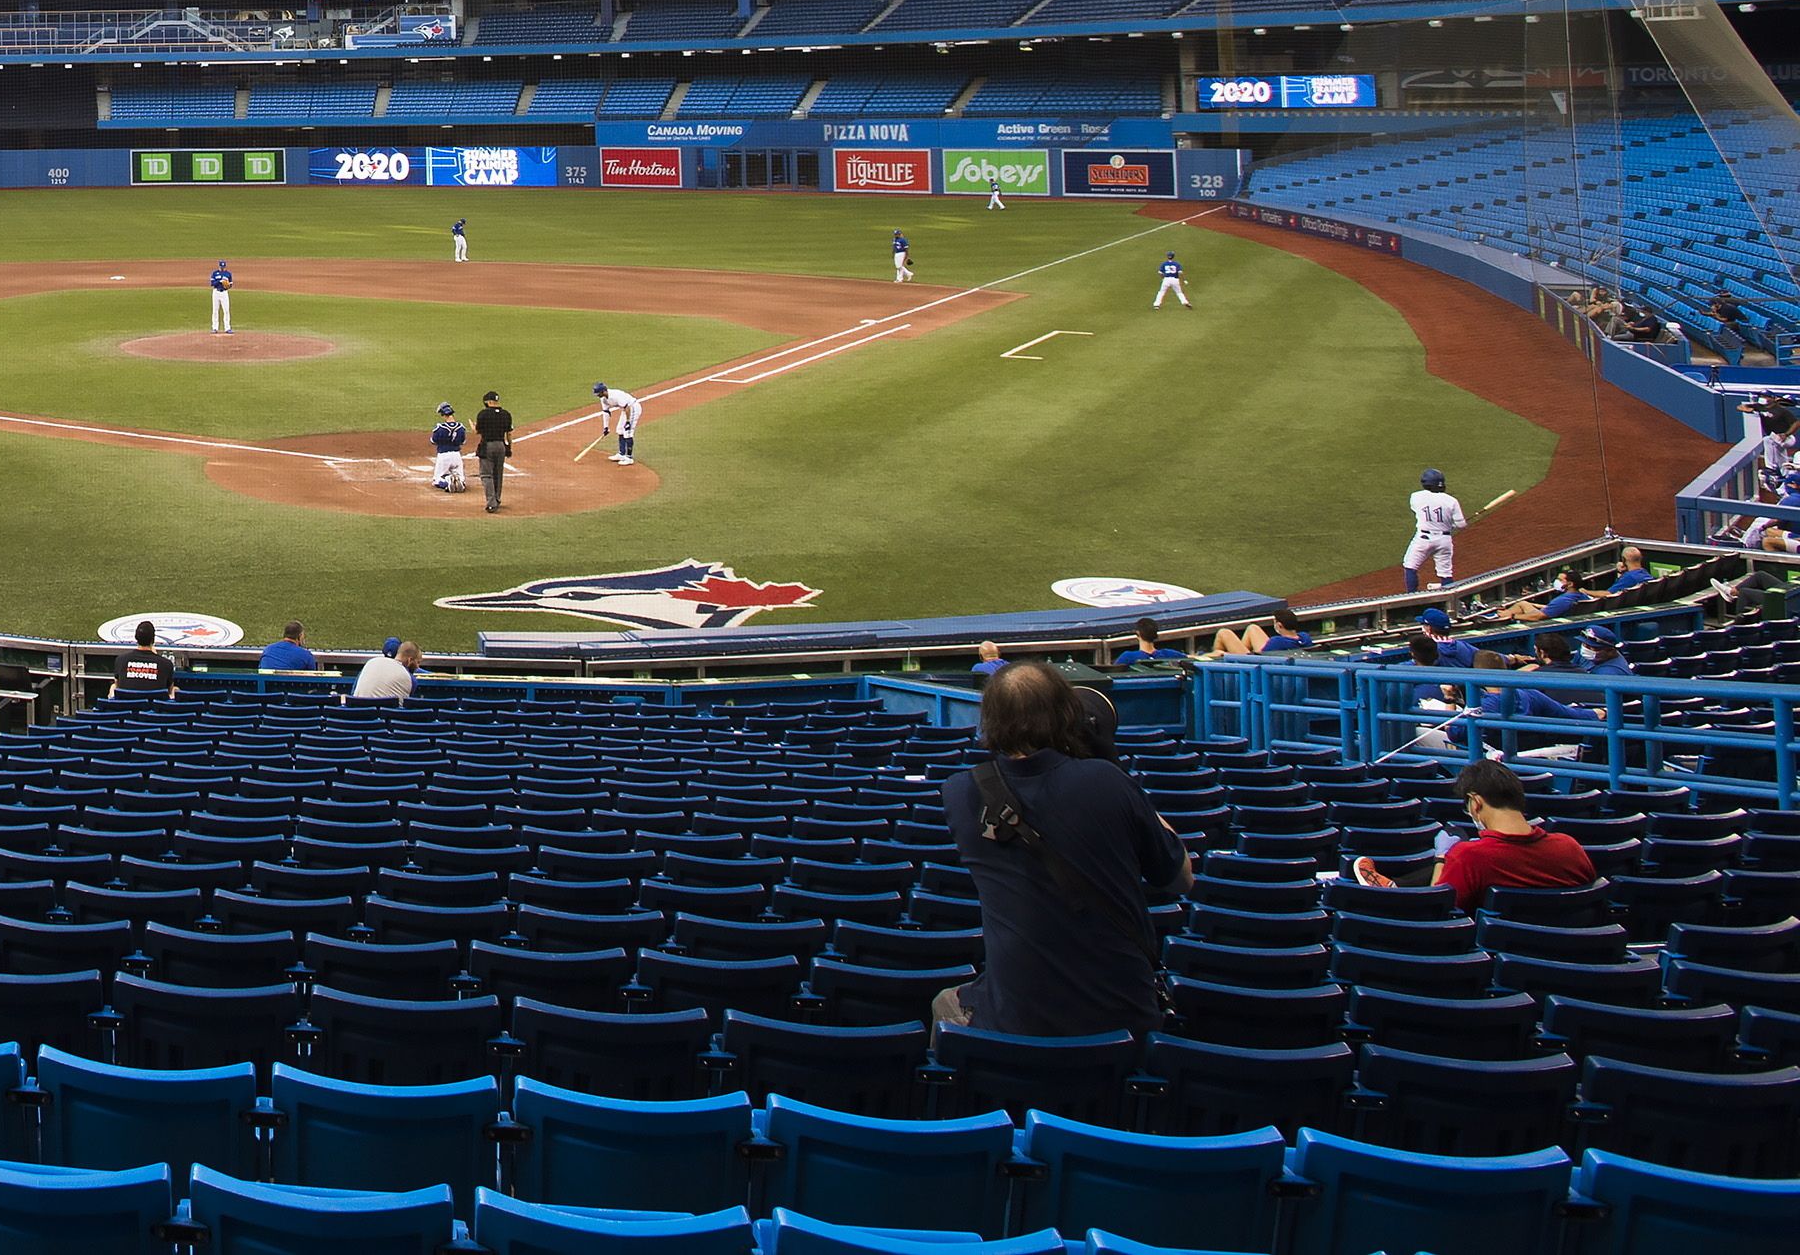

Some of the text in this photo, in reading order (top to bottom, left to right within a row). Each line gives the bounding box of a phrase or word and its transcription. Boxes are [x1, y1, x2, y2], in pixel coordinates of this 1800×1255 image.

[1628, 66, 1728, 82] TORONTO
[1210, 81, 1271, 103] 2020
[1311, 92, 1358, 104] CAMP
[647, 124, 743, 136] CANADA MOVING
[823, 123, 909, 142] PIZZA NOVA
[997, 123, 1110, 134] Active Green Ross
[463, 149, 517, 160] SUMMER
[143, 157, 273, 175] TD TD TD
[334, 152, 410, 182] 2020
[463, 159, 518, 170] TRAINING
[604, 158, 676, 177] Tim Hortons
[47, 168, 70, 179] 400
[463, 169, 519, 186] CAMP
[565, 166, 587, 178] 375
[949, 156, 1044, 187] Sobeys
[1190, 174, 1224, 188] 328
[1199, 189, 1216, 197] 100
[1164, 265, 1177, 274] 53
[1421, 505, 1444, 523] 11
[127, 661, 158, 670] PREPARE
[126, 672, 158, 680] RECOVER
